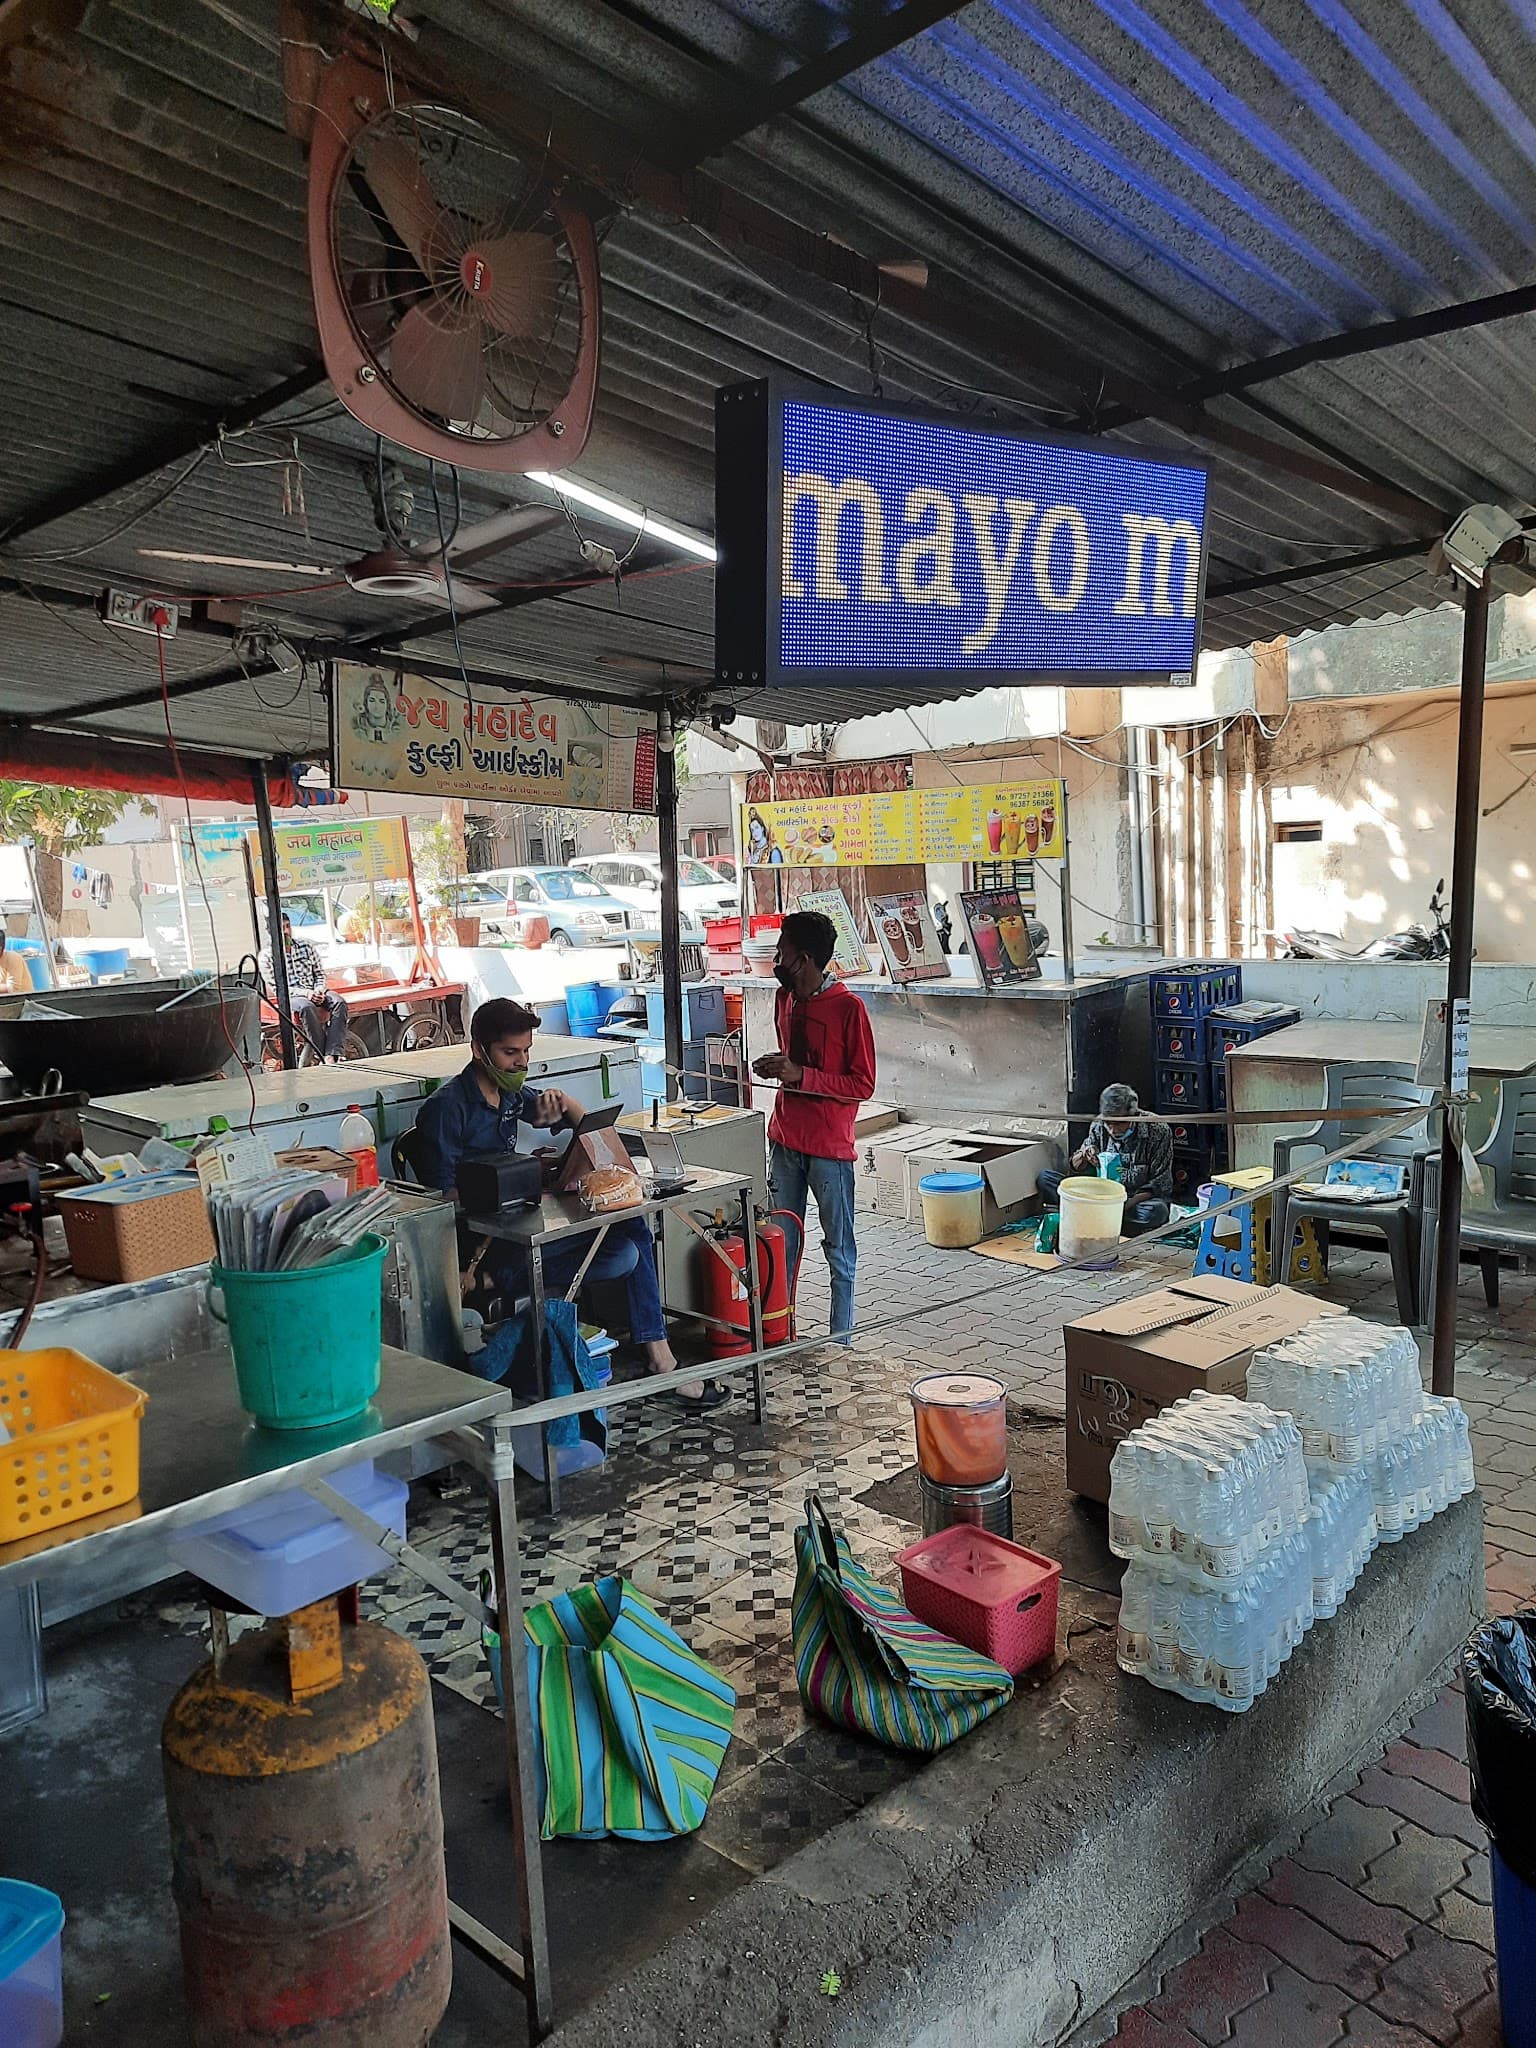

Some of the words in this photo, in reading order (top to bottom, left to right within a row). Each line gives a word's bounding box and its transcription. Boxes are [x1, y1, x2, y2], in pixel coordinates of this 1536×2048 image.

[782, 470, 1089, 657] mayo
[395, 694, 449, 731] જય
[463, 697, 557, 744] મહાદેવ
[406, 738, 463, 776] કુલ્ફી
[286, 834, 312, 849] जय
[315, 823, 363, 851] महादेव
